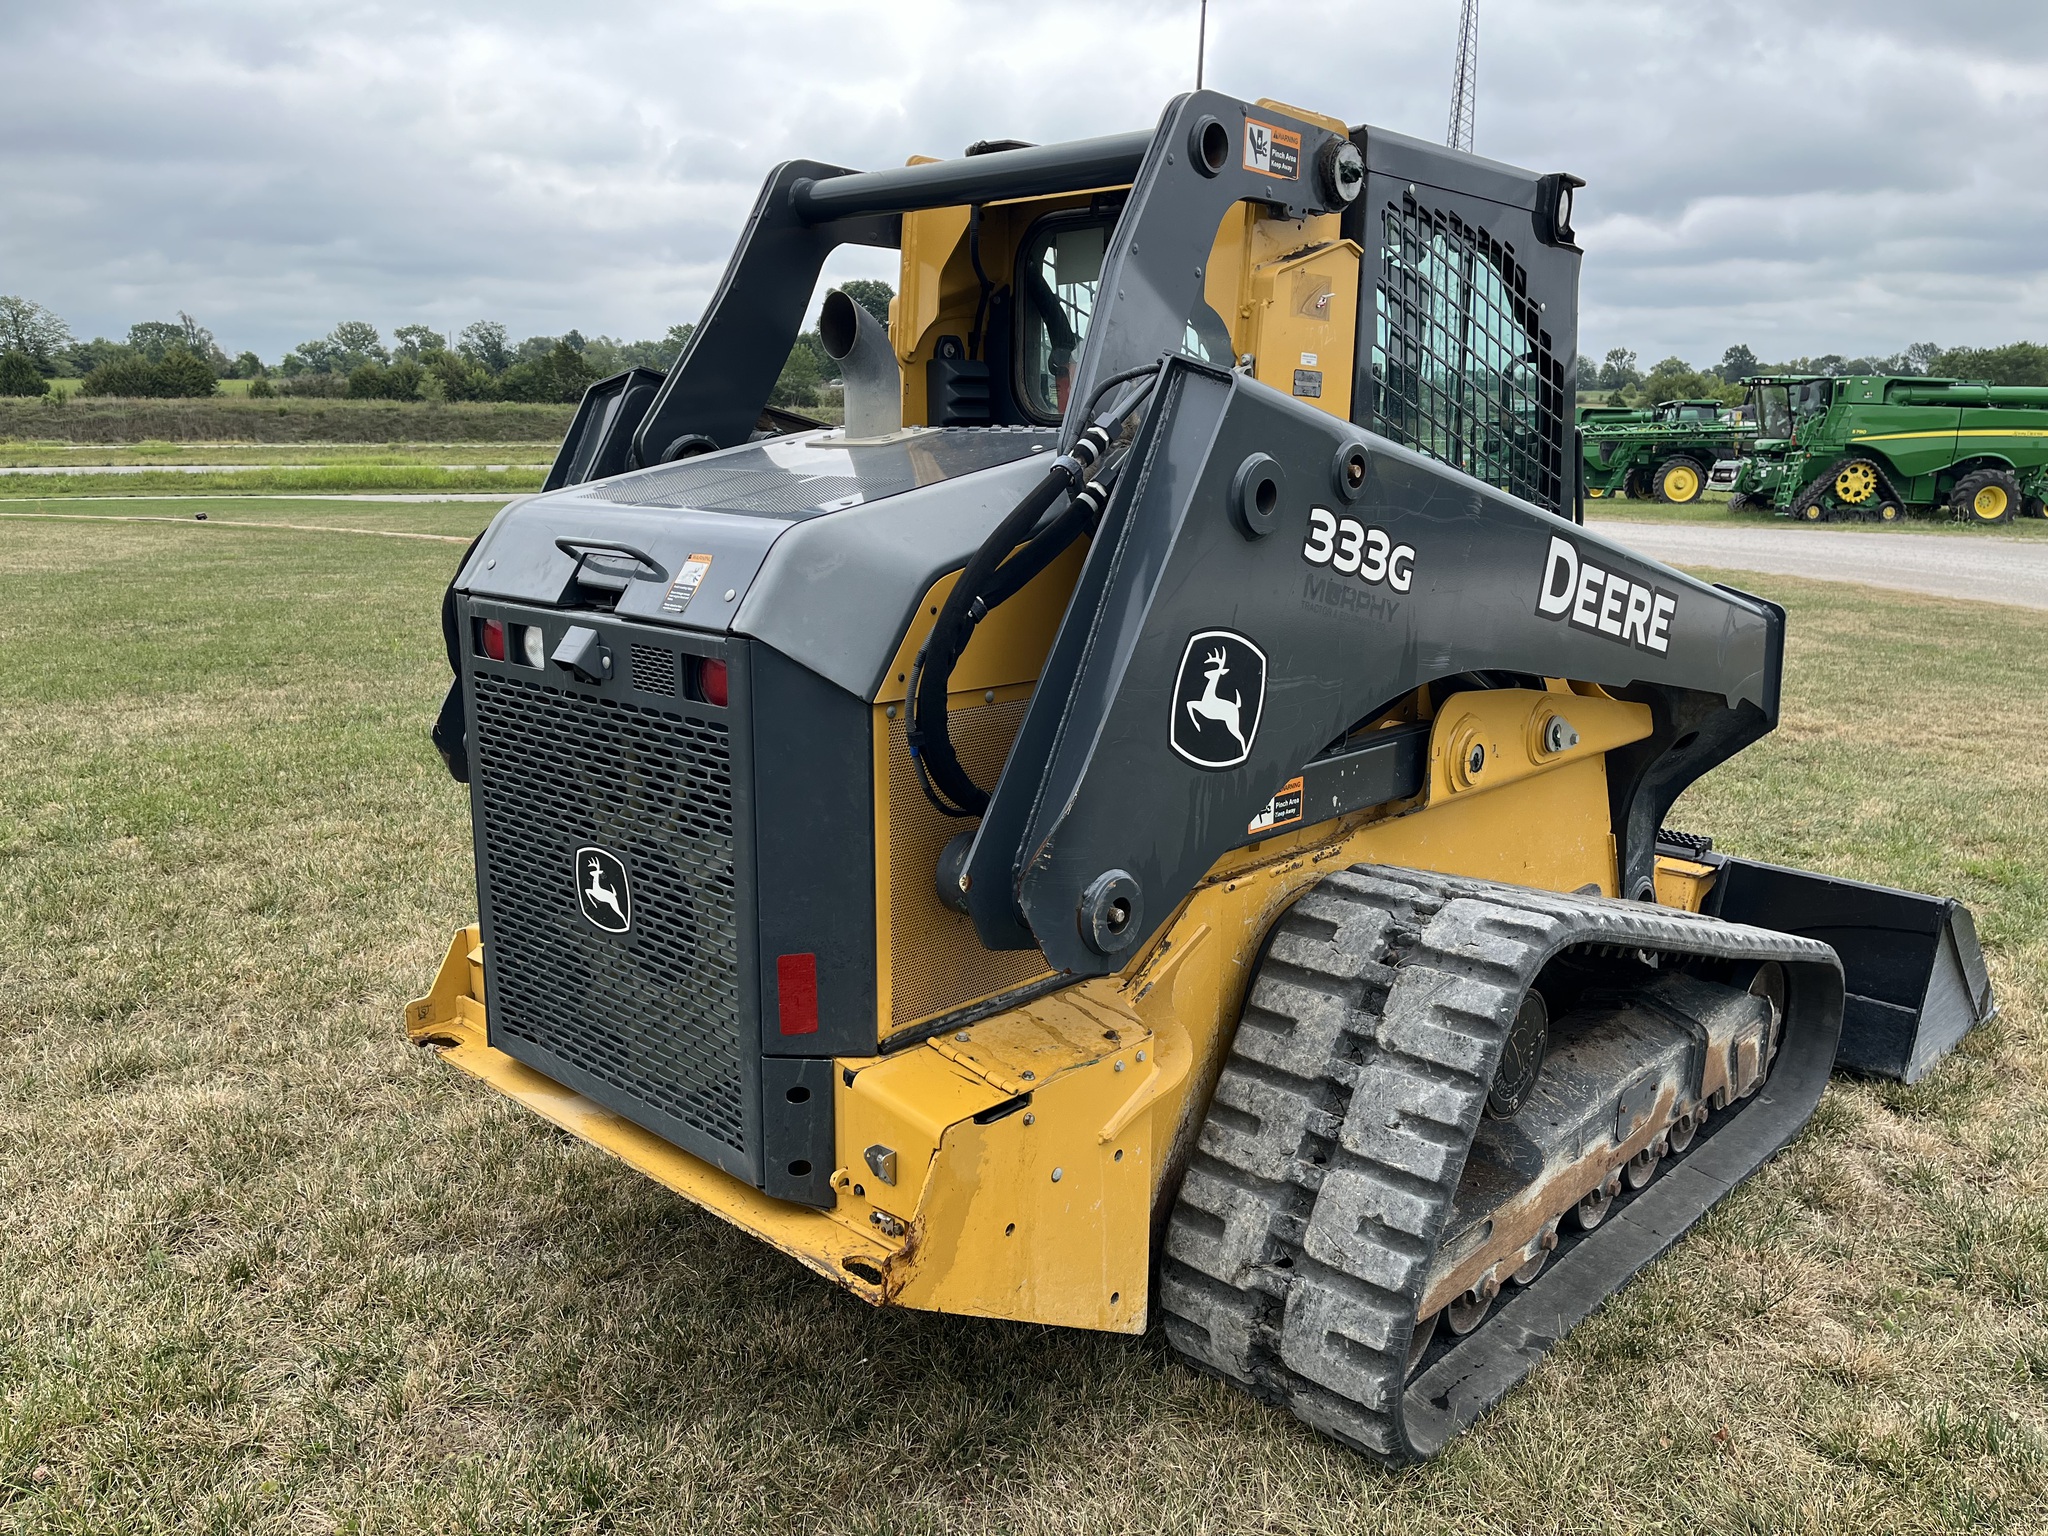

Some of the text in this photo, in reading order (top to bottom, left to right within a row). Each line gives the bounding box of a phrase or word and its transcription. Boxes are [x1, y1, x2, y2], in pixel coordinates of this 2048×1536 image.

[1278, 134, 1298, 144] WARNING
[1271, 149, 1297, 163] Pinch Area
[1271, 159, 1293, 173] Keep Away
[1303, 508, 1416, 592] 333G
[1538, 535, 1676, 653] DEERE
[1275, 797, 1300, 810] Pinch Area
[1285, 807, 1296, 815] Away
